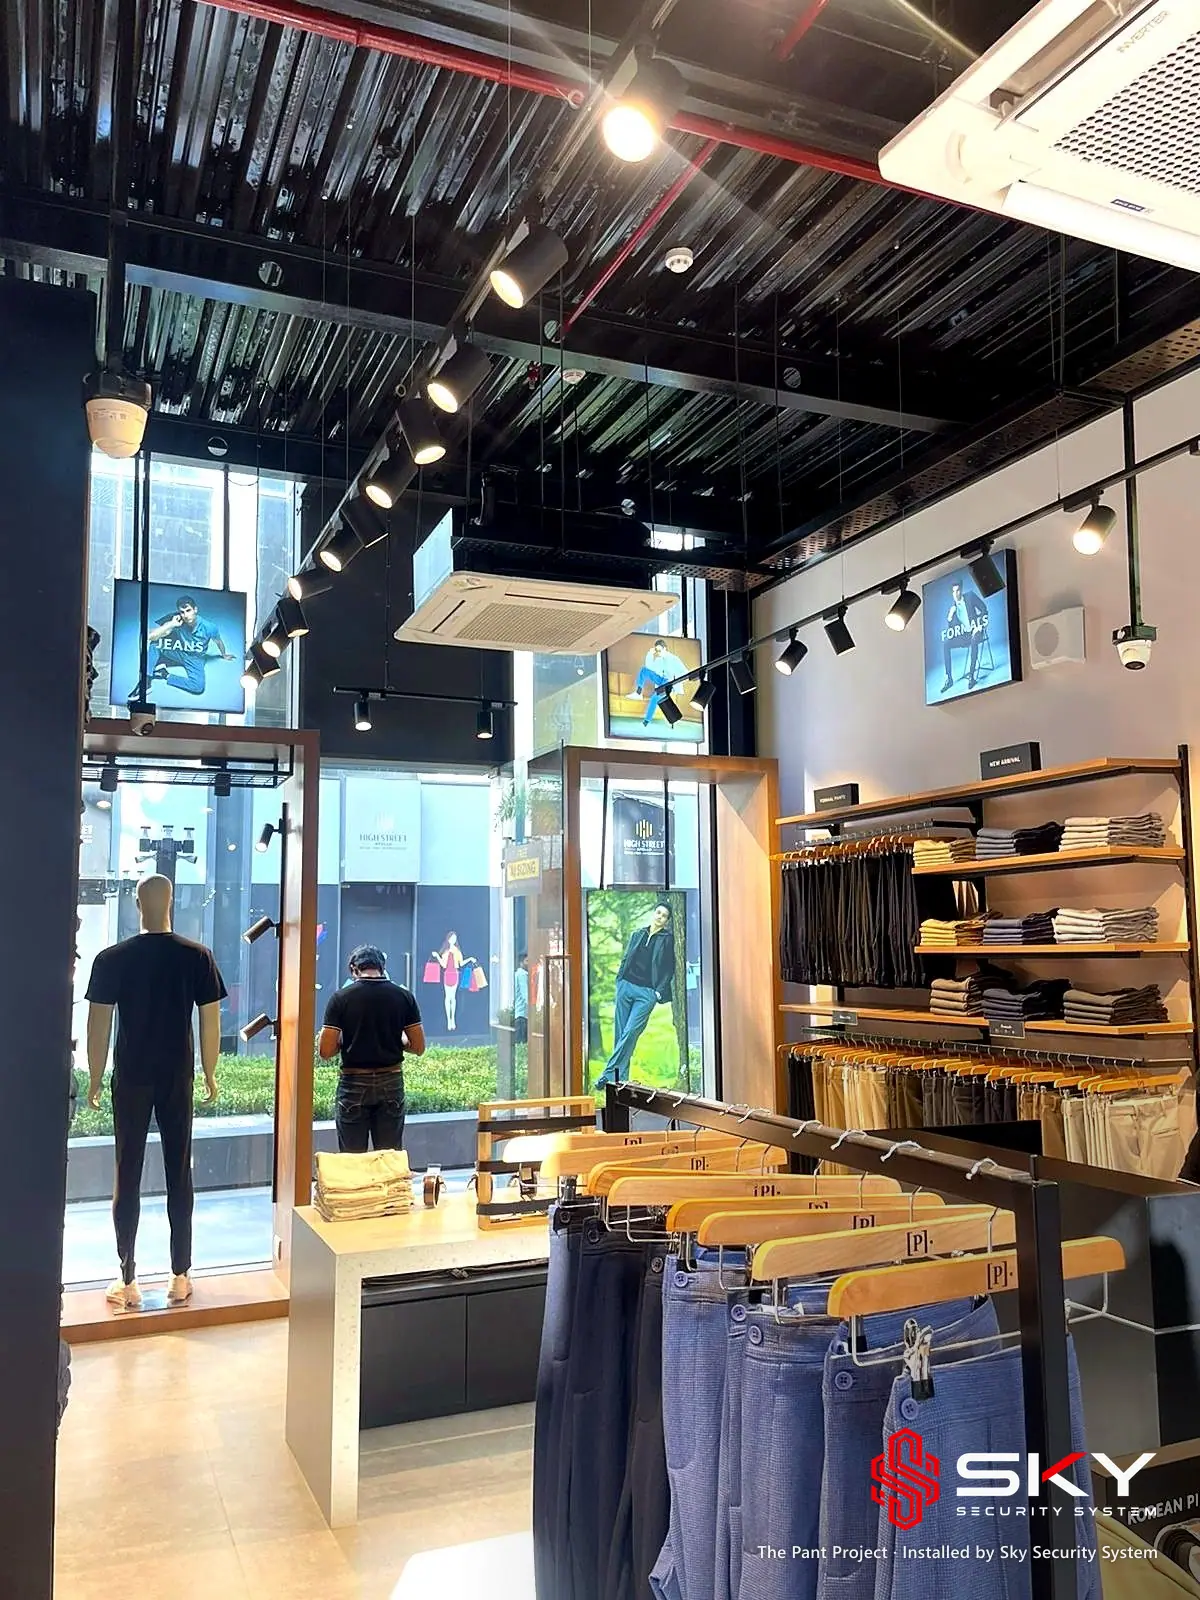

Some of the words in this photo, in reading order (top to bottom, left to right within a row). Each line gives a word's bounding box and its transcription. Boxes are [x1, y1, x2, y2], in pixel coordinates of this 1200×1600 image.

[1116, 10, 1168, 53] INVERTER
[156, 638, 204, 652] JEANS
[989, 759, 1001, 767] NEW
[1001, 756, 1021, 765] ARRIVAL
[359, 832, 380, 841] HIGH
[380, 833, 408, 842] STREET
[623, 840, 641, 848] HIGH
[641, 840, 665, 849] STREET
[1127, 1496, 1183, 1526] KOREAN
